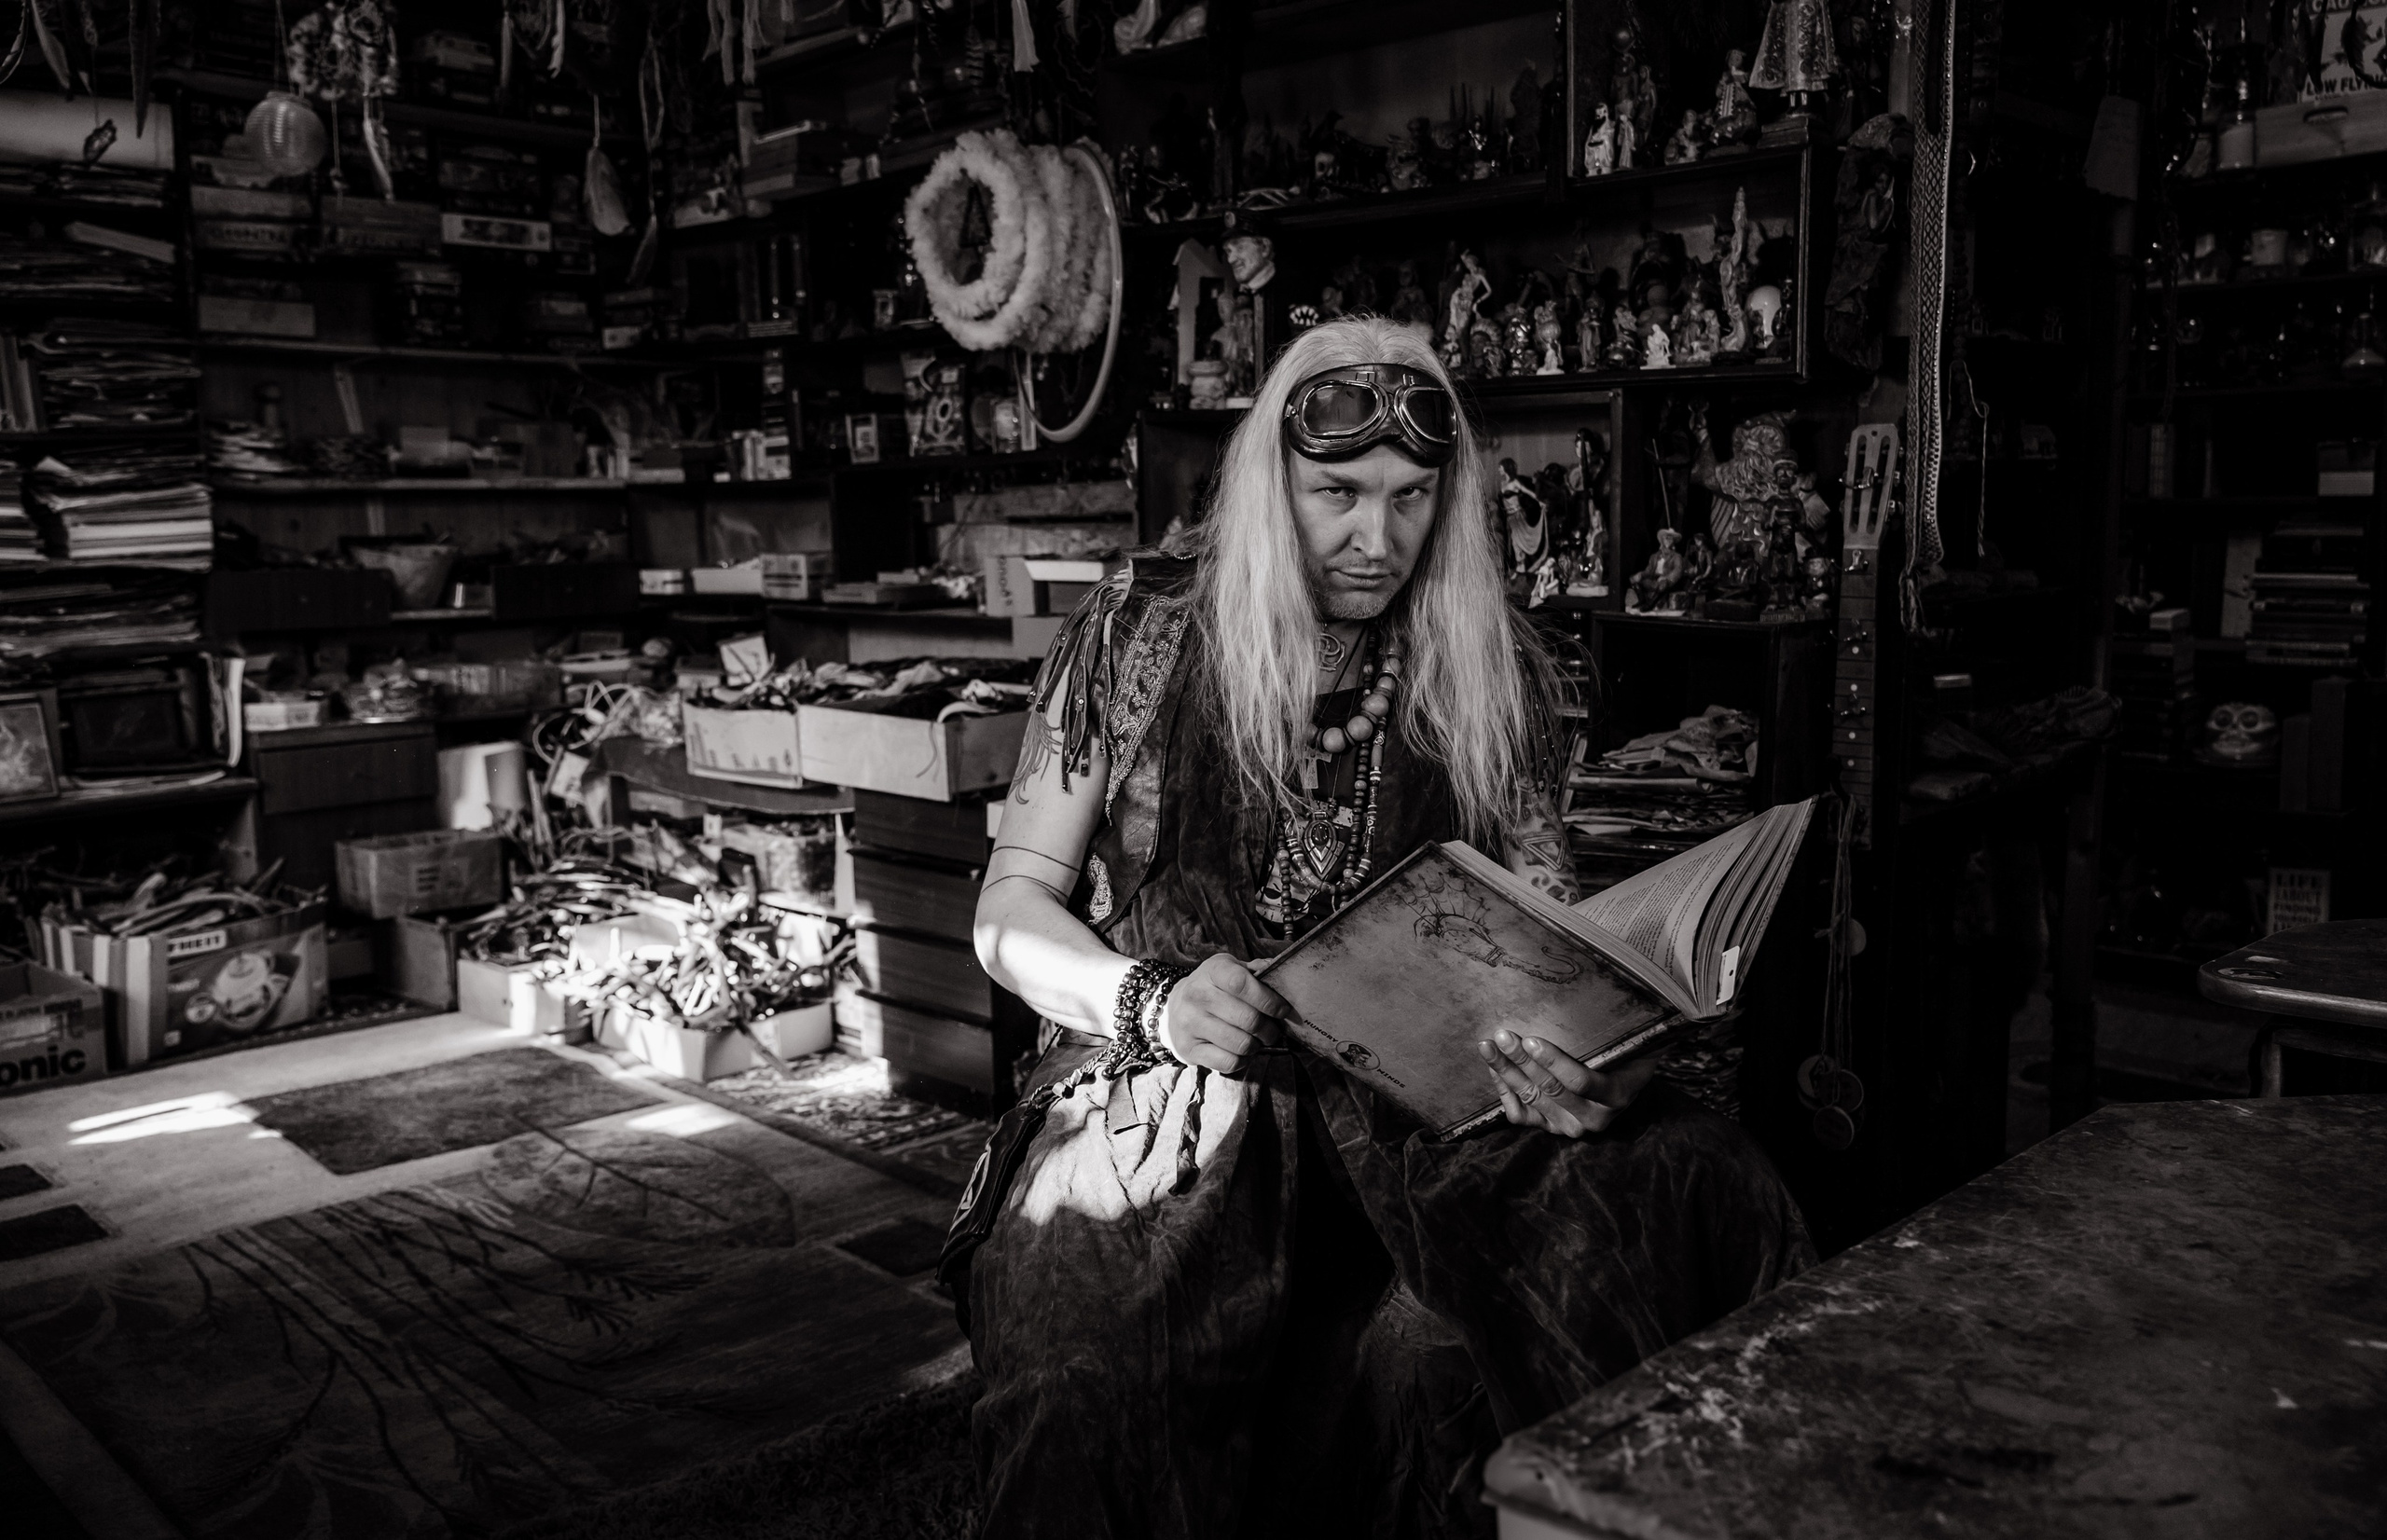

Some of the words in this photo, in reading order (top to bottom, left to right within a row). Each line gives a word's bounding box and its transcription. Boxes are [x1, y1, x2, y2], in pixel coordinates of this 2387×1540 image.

[2307, 78, 2337, 95] LW
[2277, 874, 2322, 888] LIFE
[1304, 1020, 1338, 1042] HUNGRY
[1376, 1068, 1405, 1089] MINDS
